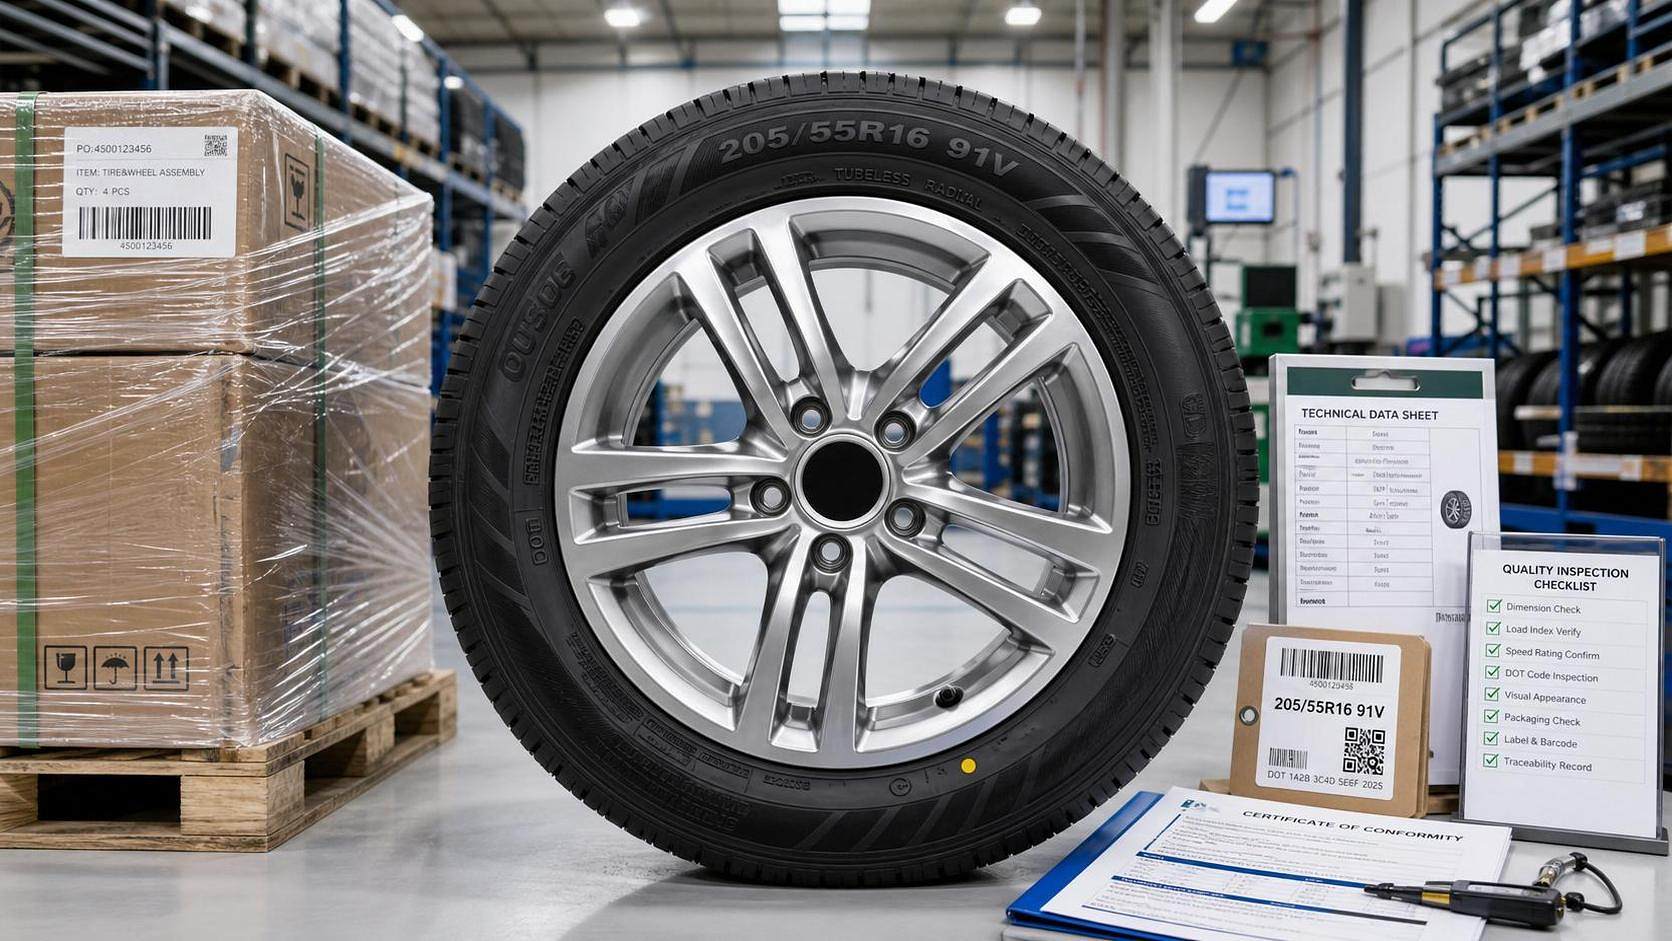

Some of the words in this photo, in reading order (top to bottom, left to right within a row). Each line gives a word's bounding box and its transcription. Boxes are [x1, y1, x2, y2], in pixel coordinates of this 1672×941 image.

[718, 119, 931, 165] 205/55R16
[945, 137, 1020, 177] 91V
[76, 168, 100, 177] ITEM:
[102, 168, 157, 177] TIRE&WHEEL
[159, 168, 206, 177] ASSEMBLY
[832, 167, 911, 187] TUBELESS
[76, 187, 98, 196] QTY:
[102, 187, 108, 196] 4
[112, 187, 130, 196] PCS
[1302, 408, 1366, 420] TECHNICAL
[1369, 409, 1400, 420] DATA
[1402, 410, 1439, 421] SHEET
[1502, 564, 1554, 576] QUALITY
[1556, 566, 1630, 578] INSPECTION
[1534, 580, 1598, 592] CHECKLIST
[1506, 602, 1552, 613] Dimension
[1554, 604, 1582, 614] Check
[1506, 624, 1528, 634] Load
[1530, 626, 1554, 636] Index
[1556, 627, 1582, 638] Verify
[1506, 647, 1532, 658] Speed
[1535, 648, 1563, 660] Rating
[1564, 650, 1600, 660] Confirm
[1505, 669, 1525, 678] DOT
[1527, 670, 1551, 680] Code
[1553, 672, 1599, 683] Inspection
[1505, 691, 1531, 701] Visual
[1533, 692, 1587, 704] Appearance
[1274, 697, 1352, 716] 205/55R16
[1357, 704, 1385, 719] 91V
[1504, 712, 1550, 726] Packaging
[1552, 716, 1581, 726] Check
[1504, 735, 1529, 745] Label
[1530, 737, 1538, 746] &
[1541, 738, 1578, 749] Barcode
[1504, 757, 1557, 770] Traceability
[1560, 761, 1592, 772] Record
[1267, 770, 1286, 780] DOT
[1290, 772, 1310, 783] 1A2B
[1242, 810, 1336, 828] CERTIFICATE
[1339, 823, 1361, 831] OF
[1364, 826, 1464, 842] CONFORMITY
